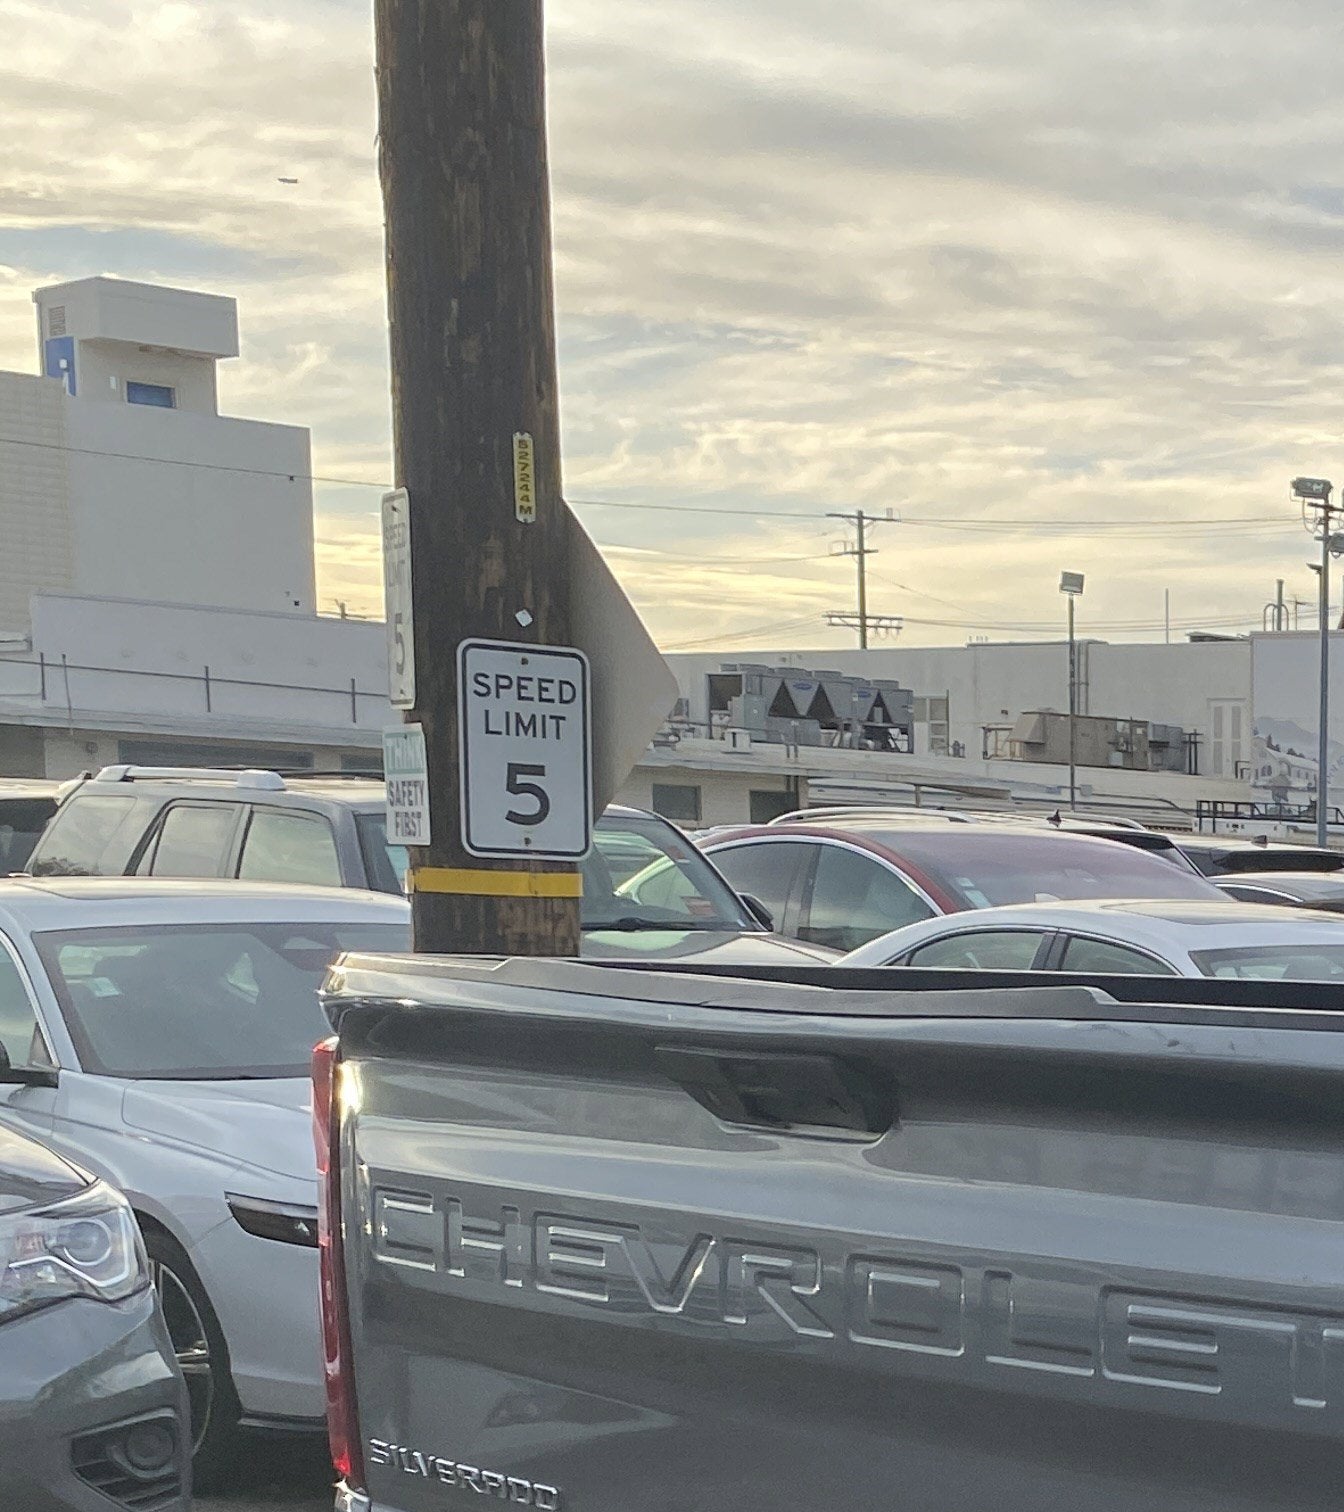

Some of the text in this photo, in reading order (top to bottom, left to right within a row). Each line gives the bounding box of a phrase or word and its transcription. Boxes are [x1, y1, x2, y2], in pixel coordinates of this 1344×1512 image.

[473, 672, 577, 705] SPEED
[484, 709, 567, 740] LIMIT
[389, 780, 425, 807] SAFETY
[505, 762, 550, 826] 5
[395, 811, 422, 838] FIRST
[370, 1438, 560, 1511] SILVERADO
